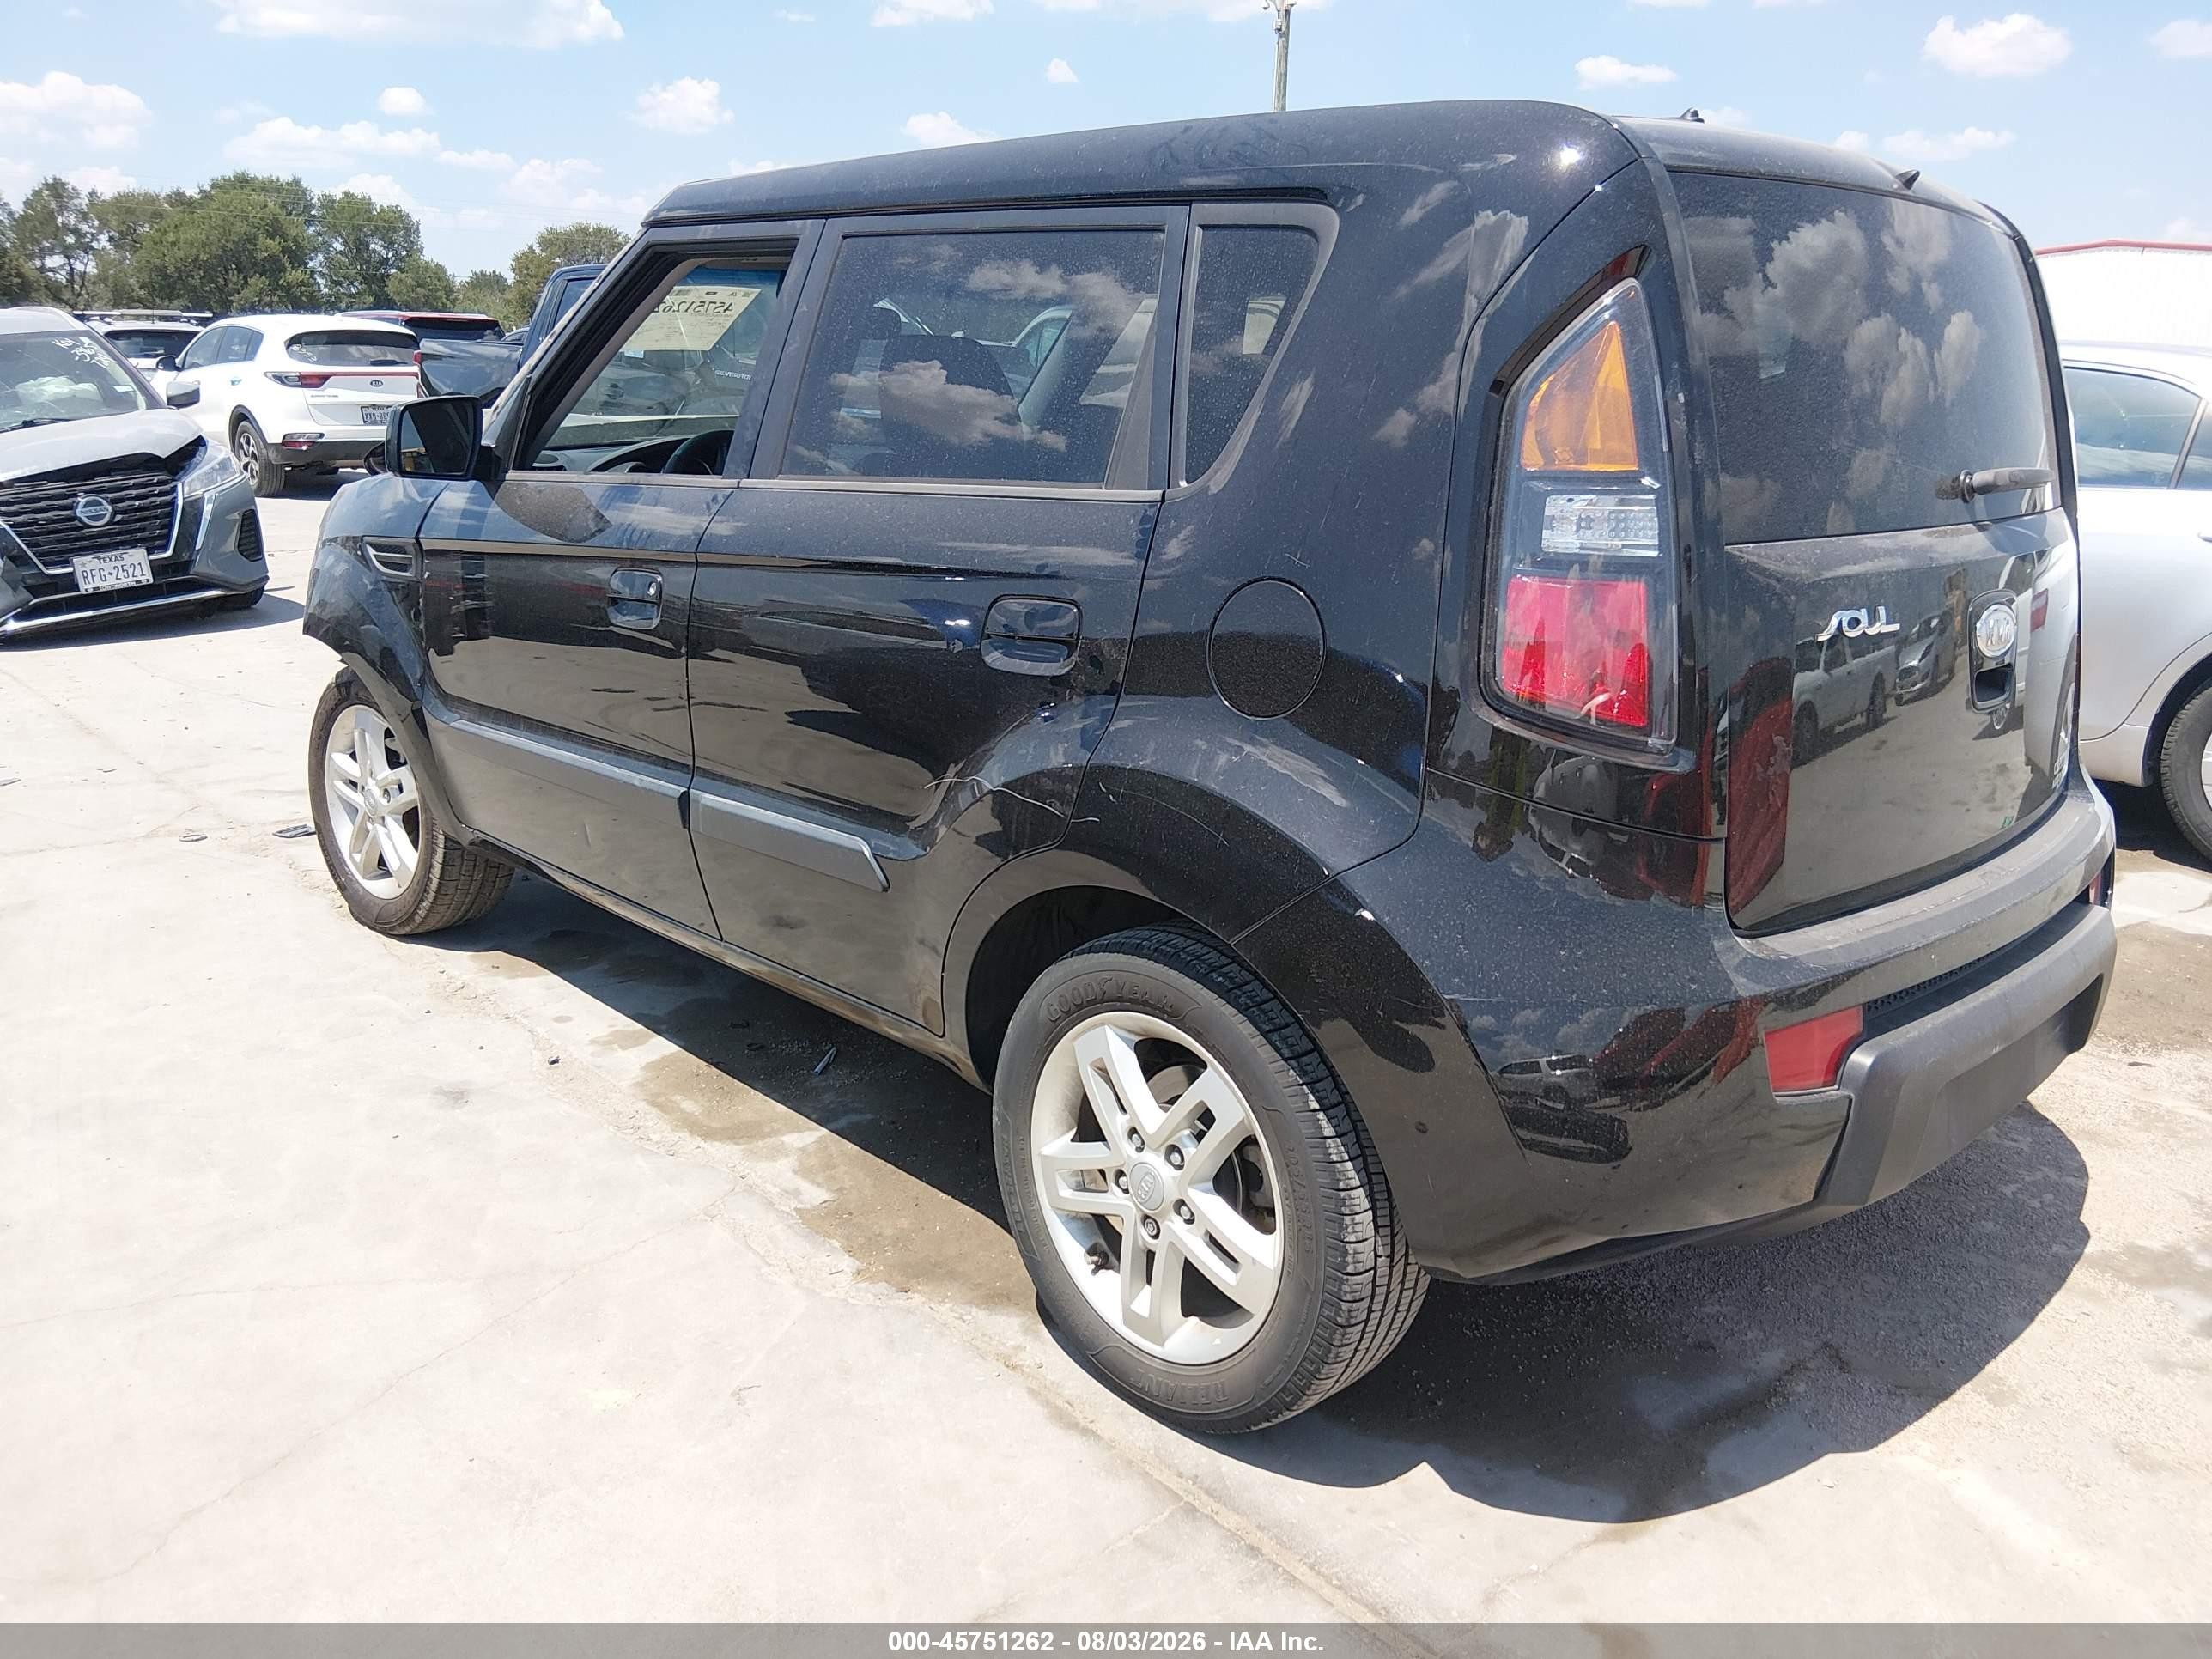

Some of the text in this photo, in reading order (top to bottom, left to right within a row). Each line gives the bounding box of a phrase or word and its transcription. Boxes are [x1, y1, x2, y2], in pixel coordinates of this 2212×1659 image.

[96, 553, 125, 564] TEXAS
[1814, 605, 1901, 642] SOUL
[1984, 617, 2012, 647] KIA
[1046, 975, 1175, 1022] GOODYEAR
